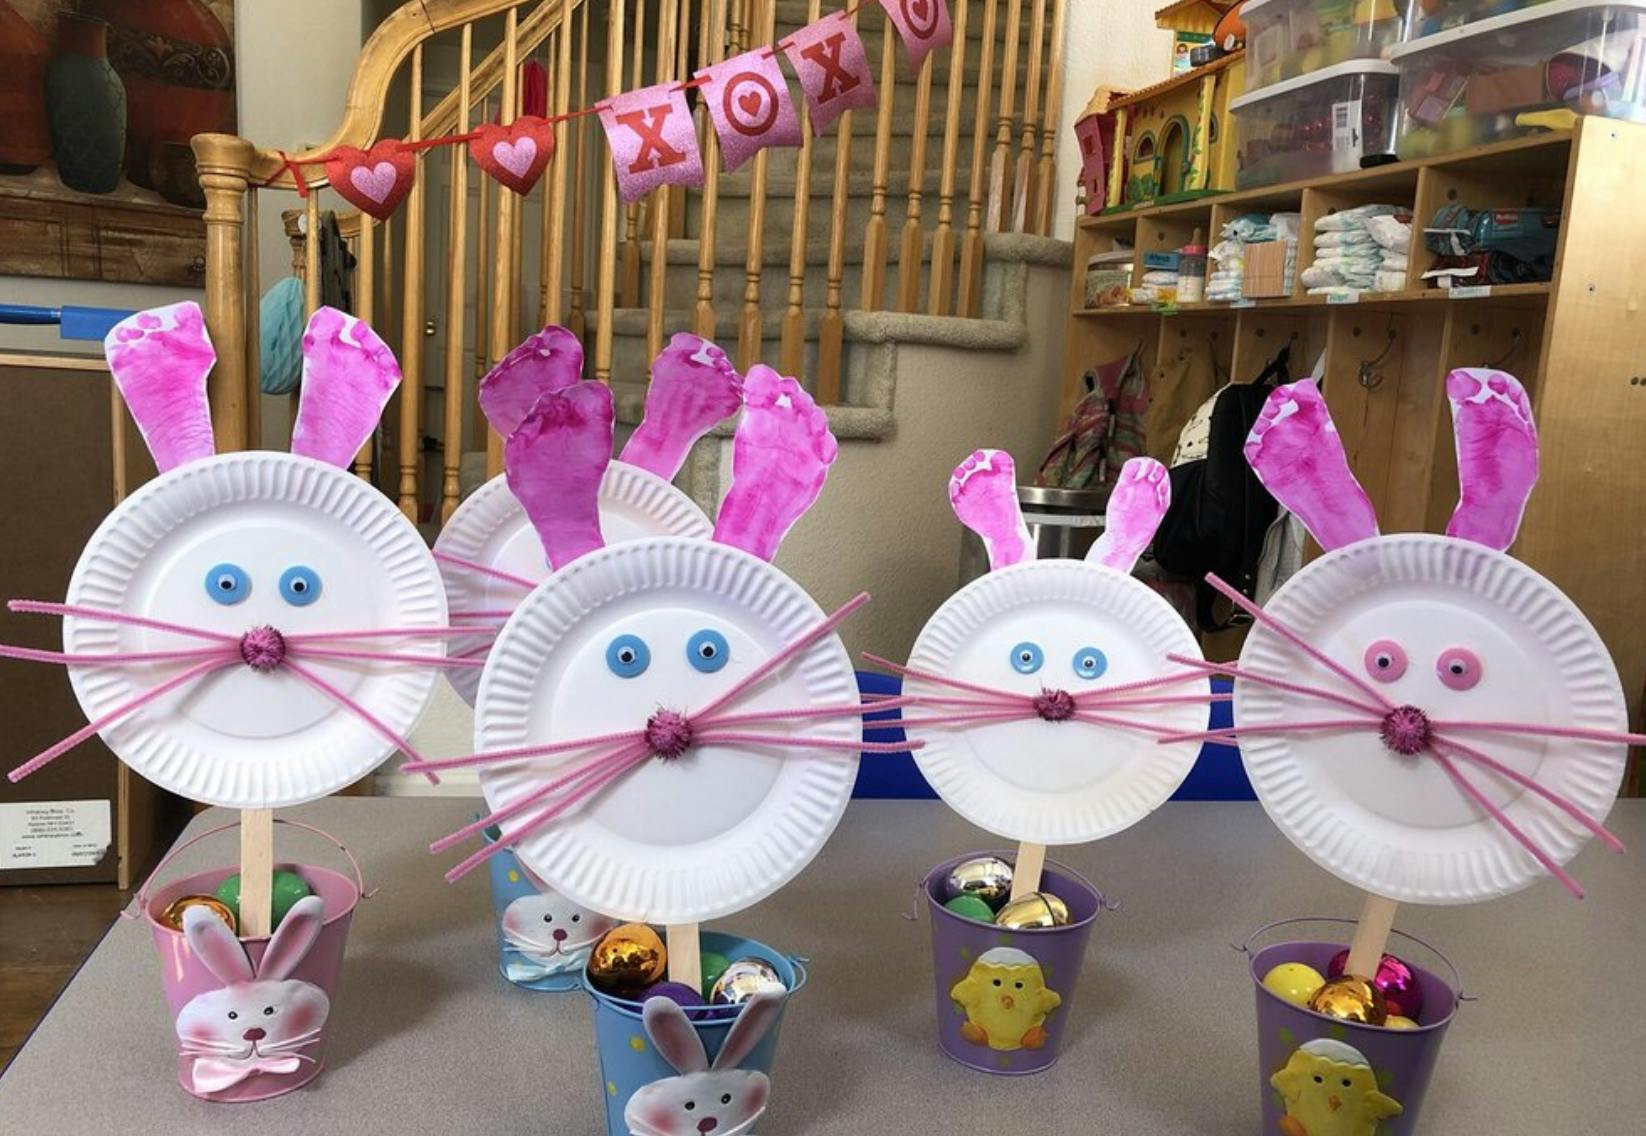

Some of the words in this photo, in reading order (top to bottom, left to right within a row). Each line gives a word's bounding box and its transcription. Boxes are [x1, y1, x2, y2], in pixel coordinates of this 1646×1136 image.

[616, 104, 686, 174] X
[722, 71, 780, 137] O
[800, 31, 861, 104] X
